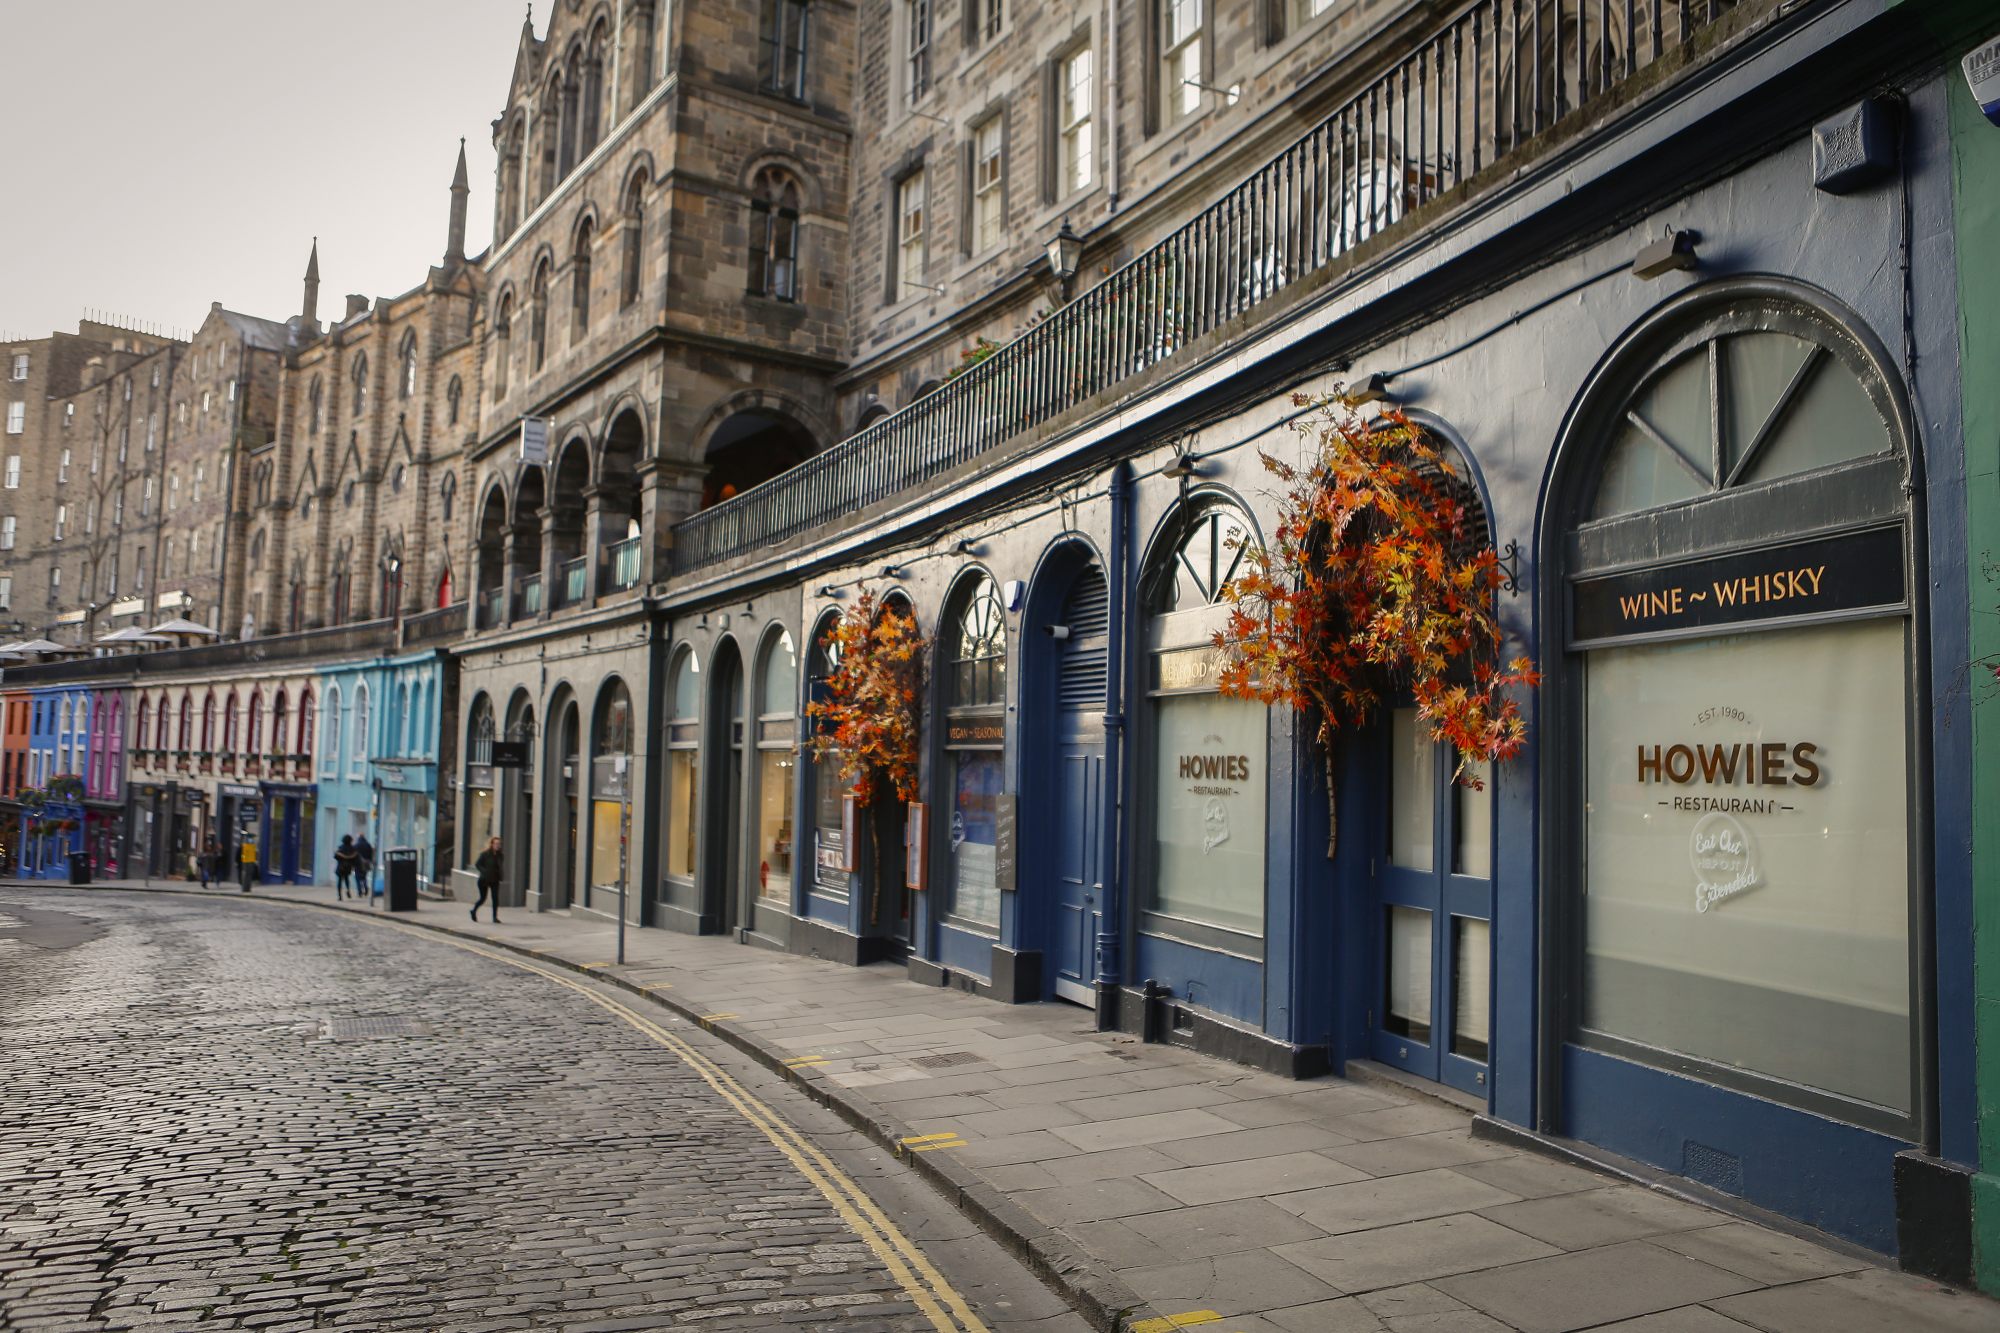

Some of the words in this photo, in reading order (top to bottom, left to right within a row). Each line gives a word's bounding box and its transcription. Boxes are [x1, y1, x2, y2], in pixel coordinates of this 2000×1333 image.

[1969, 42, 2000, 71] IM
[1620, 588, 1683, 620] WINE
[1713, 566, 1825, 608] WHISKY
[1164, 662, 1207, 682] EAFOOD
[1722, 706, 1745, 722] 1990
[949, 727, 968, 739] VEGAN
[974, 726, 1005, 739] SEASONAL
[1179, 755, 1250, 782] HOWIES
[1638, 742, 1820, 786] HOWIES
[1193, 785, 1233, 796] RESTAURANT
[1674, 796, 1775, 814] RESTAURANT
[1696, 832, 1716, 854] Eat
[1719, 829, 1742, 855] Out
[1696, 866, 1758, 913] Extended
